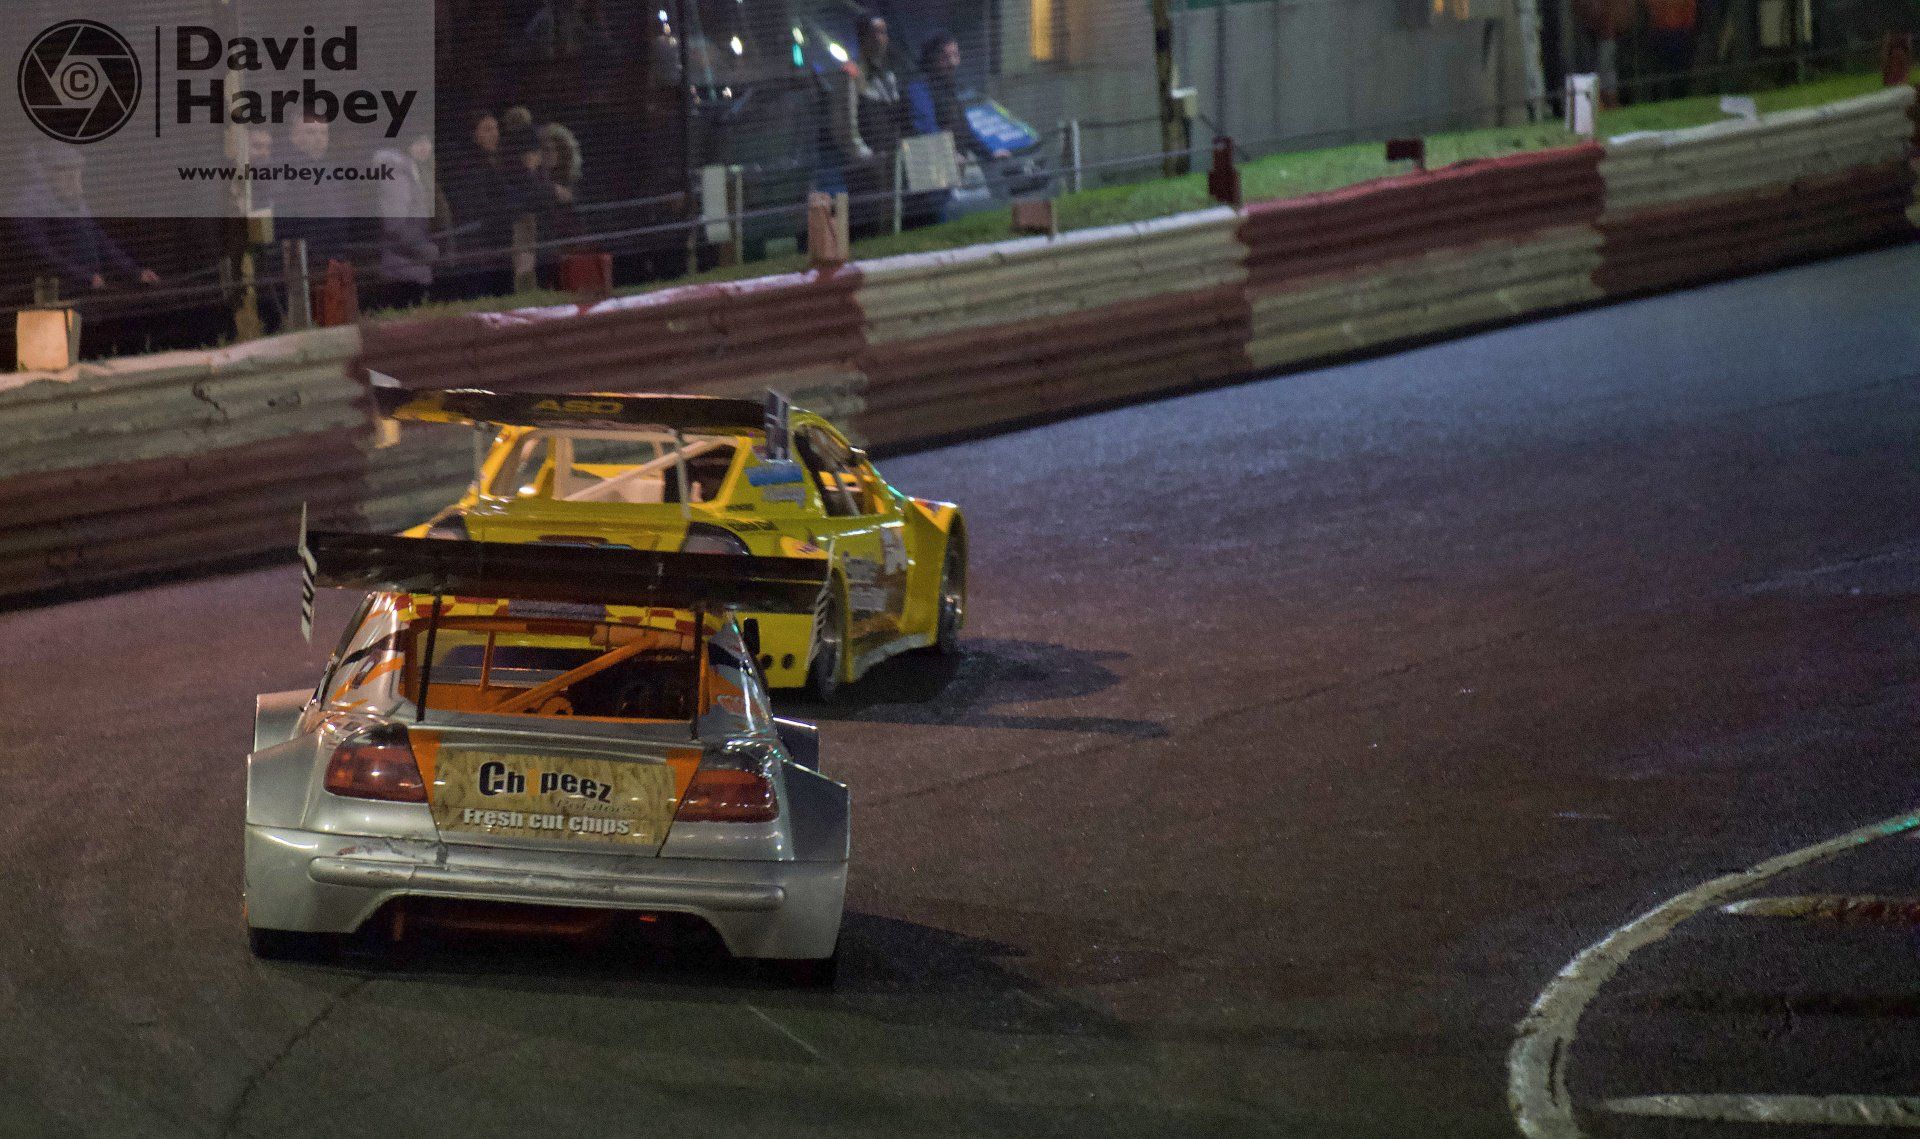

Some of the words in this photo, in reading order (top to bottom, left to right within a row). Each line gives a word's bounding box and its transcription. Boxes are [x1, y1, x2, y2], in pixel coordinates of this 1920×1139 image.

[463, 808, 524, 829] Fresh
[528, 813, 565, 831] cut
[568, 814, 630, 836] chips
